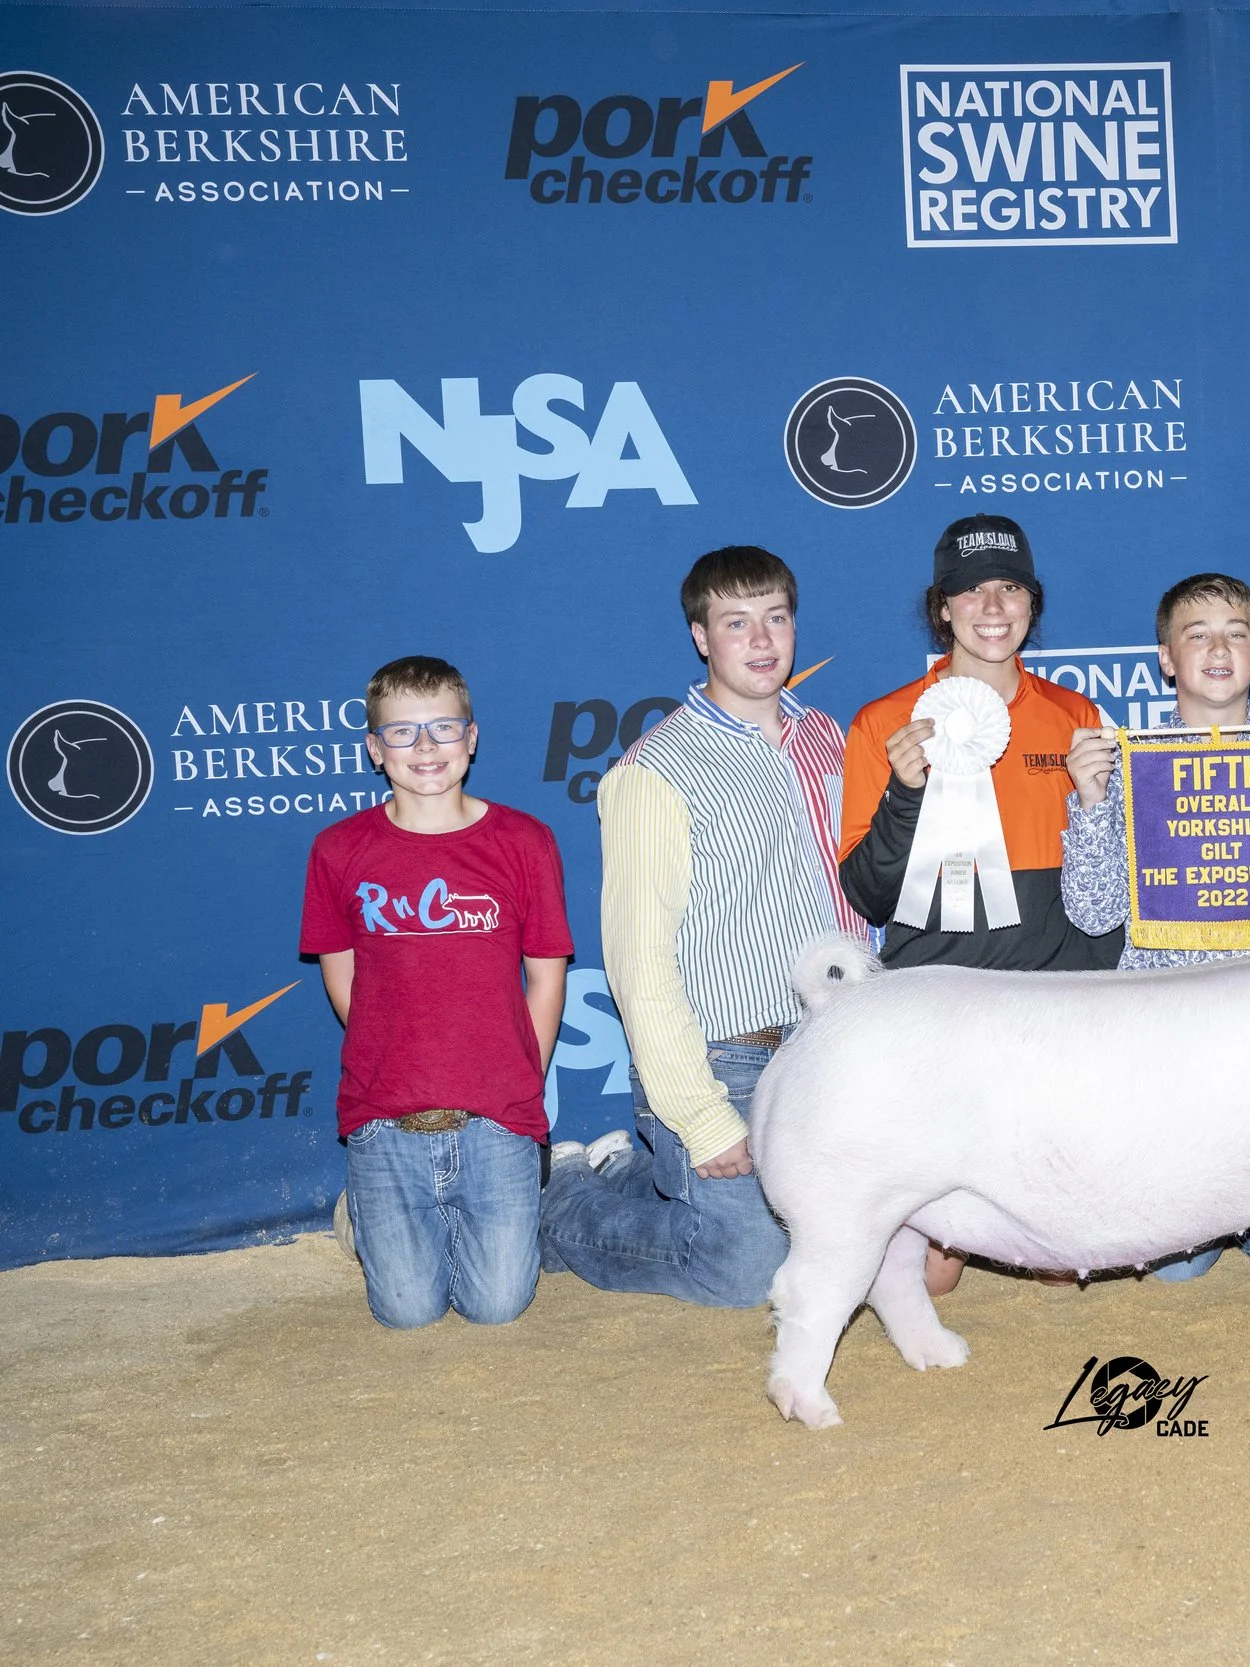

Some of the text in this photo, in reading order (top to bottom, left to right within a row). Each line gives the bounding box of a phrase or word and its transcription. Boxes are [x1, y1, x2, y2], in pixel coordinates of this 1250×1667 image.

[121, 82, 402, 118] AMERICAN
[916, 79, 1158, 119] NATIONAL
[504, 61, 806, 181] pork
[124, 128, 408, 164] BERKSHIRE
[917, 120, 1162, 184] SWINE
[154, 180, 383, 202] ASSOCIATION
[529, 155, 813, 205] checkoff
[920, 186, 1162, 232] REGISTRY
[933, 378, 1184, 416] AMERICAN
[934, 421, 1187, 458] BERKSHIRE
[359, 373, 699, 553] NJSA
[959, 469, 1162, 493] ASSOCIATION
[0, 469, 269, 523] heckoff
[956, 532, 1017, 550] TEAM SLOAN
[171, 698, 367, 737] AMERIC
[171, 742, 383, 781] BERKSH
[1022, 754, 1047, 767] TEAM
[202, 790, 394, 818] ASSOCIATI
[1201, 842, 1243, 860] GILT
[1142, 867, 1178, 886] THE
[1197, 888, 1248, 907] 2022
[0, 979, 303, 1112] pork
[18, 1071, 313, 1134] checkoff
